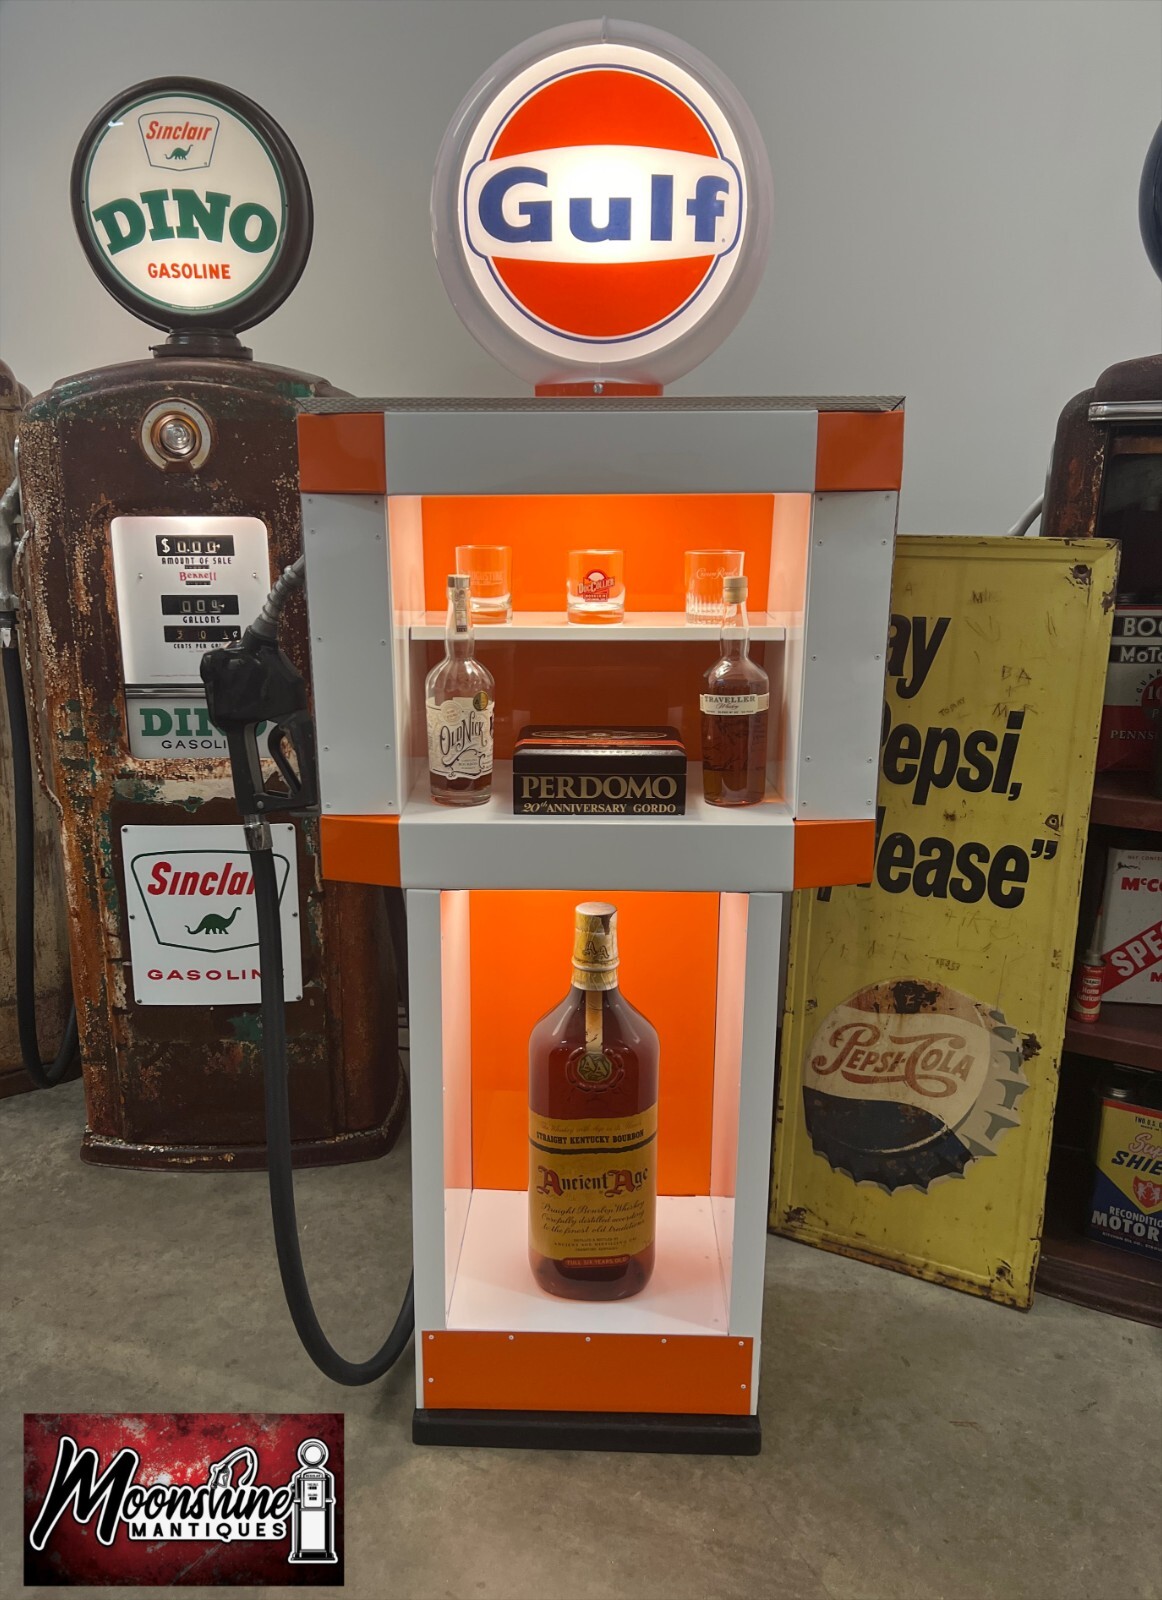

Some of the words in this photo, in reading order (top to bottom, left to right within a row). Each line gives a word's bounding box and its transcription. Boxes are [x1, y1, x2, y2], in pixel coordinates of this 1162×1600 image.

[146, 120, 212, 141] Sinclair
[478, 166, 729, 243] Gulf
[92, 188, 277, 256] DINO
[147, 263, 231, 279] GASOLINE
[179, 572, 216, 581] Bennett
[182, 616, 221, 624] GALLONS
[1123, 617, 1162, 636] BO
[161, 740, 227, 749] GASOLI
[882, 700, 1025, 805] epsi,
[521, 776, 678, 799] PERDOMO
[522, 801, 547, 813] 20th
[547, 803, 627, 813] ANNIVERSARY
[632, 803, 677, 813] GORDO
[817, 806, 1059, 909] ease”
[147, 861, 256, 896] Sinclai
[1121, 876, 1162, 892] McC
[1111, 924, 1162, 977] SPE
[147, 969, 262, 981] GASOLIN
[536, 1131, 567, 1145] STRAIGHT
[570, 1136, 610, 1145] KENTUCKY
[612, 1129, 644, 1143] BOURBON
[537, 1165, 608, 1196] Ancient
[605, 1168, 648, 1197] Age
[542, 1212, 577, 1226] Carefully
[579, 1215, 611, 1224] distilled
[612, 1210, 645, 1223] according
[577, 1204, 613, 1215] Bourbon
[551, 1225, 563, 1233] the
[564, 1225, 589, 1236] finest
[592, 1225, 607, 1233] old
[1092, 1210, 1160, 1242] MOTOR
